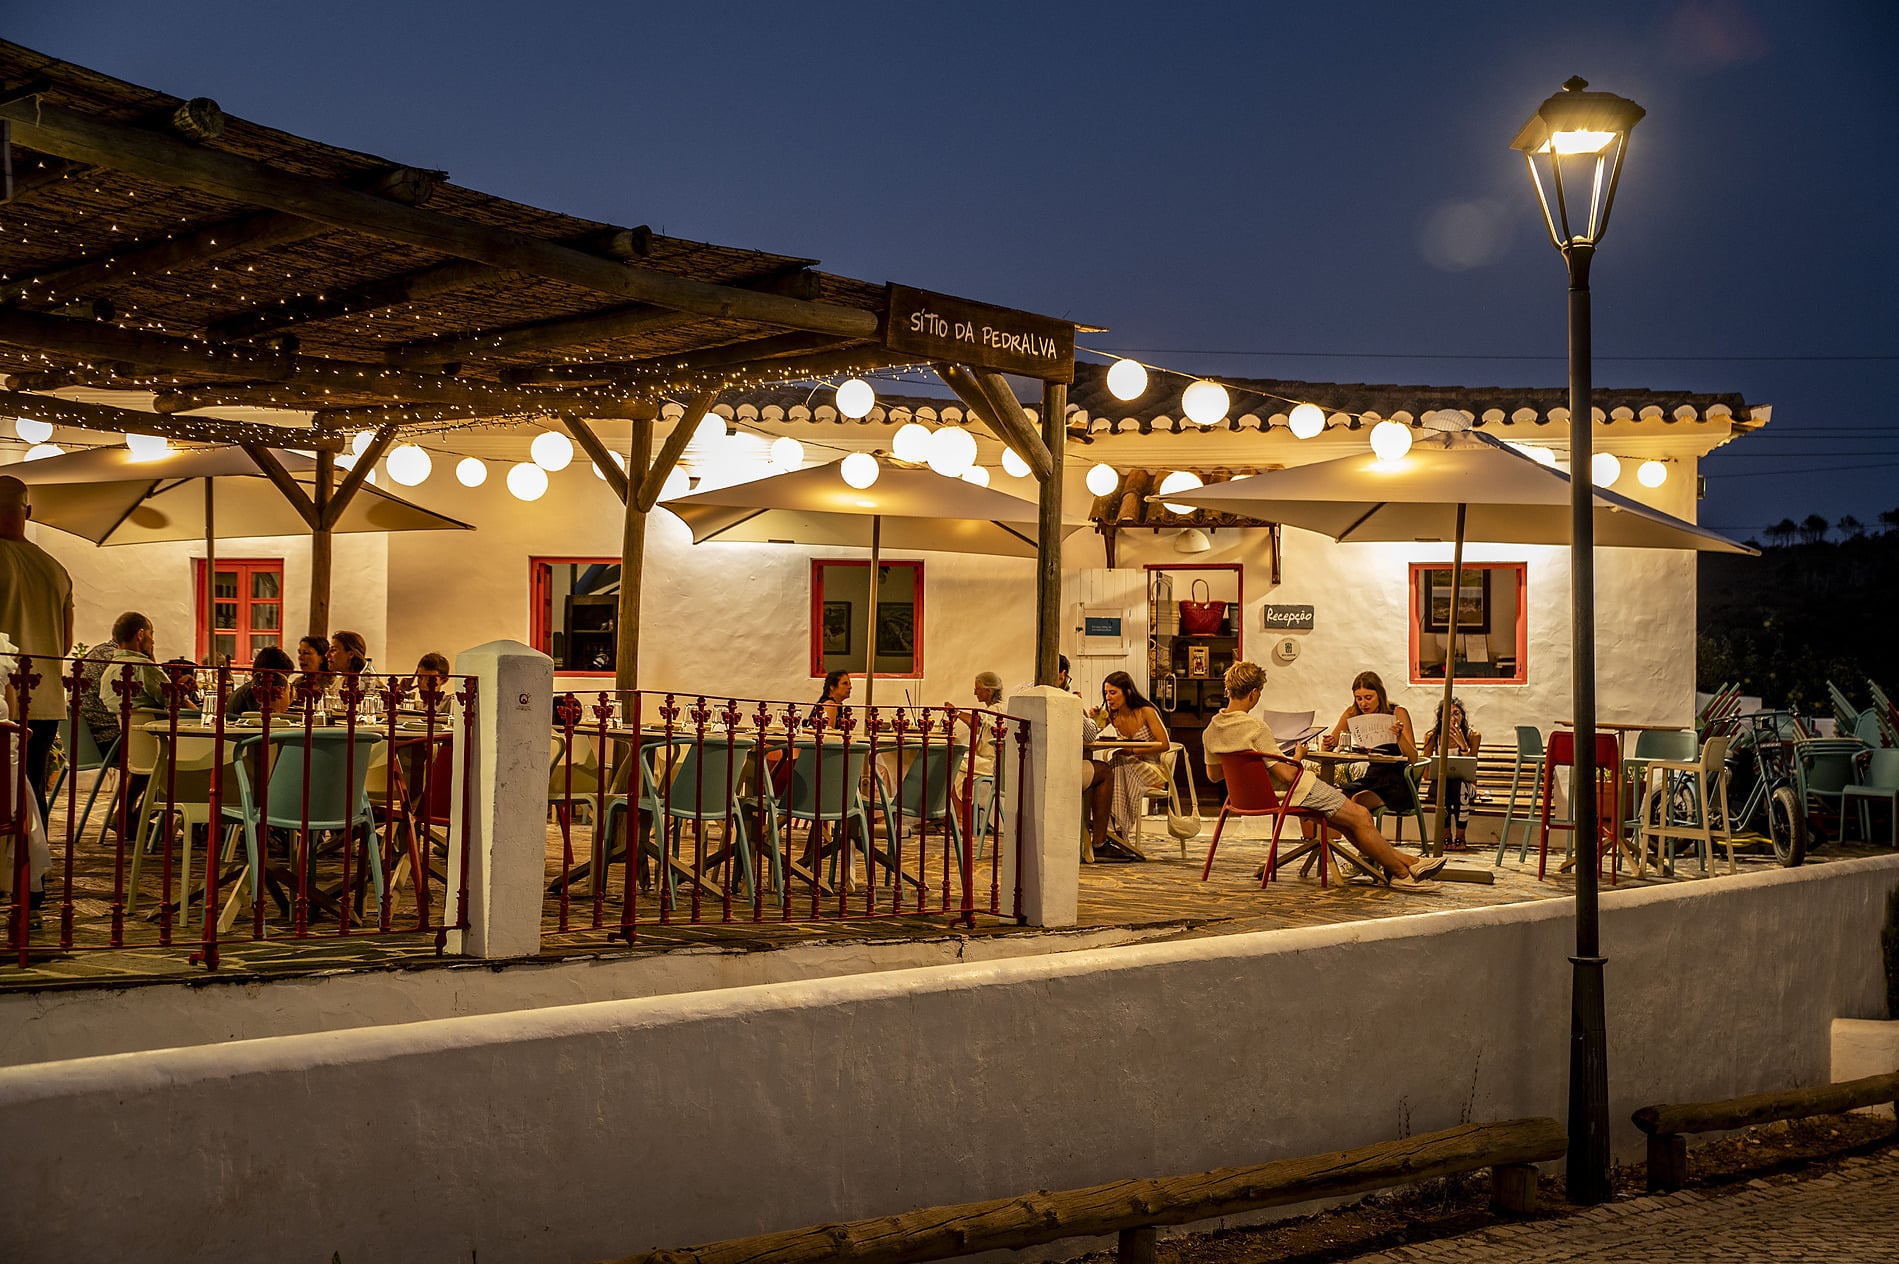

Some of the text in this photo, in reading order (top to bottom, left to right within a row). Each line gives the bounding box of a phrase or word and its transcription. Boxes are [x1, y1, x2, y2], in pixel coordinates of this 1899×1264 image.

[910, 308, 1057, 360] SÍTIO DA PEDRALVA
[1266, 607, 1313, 627] Recepção
